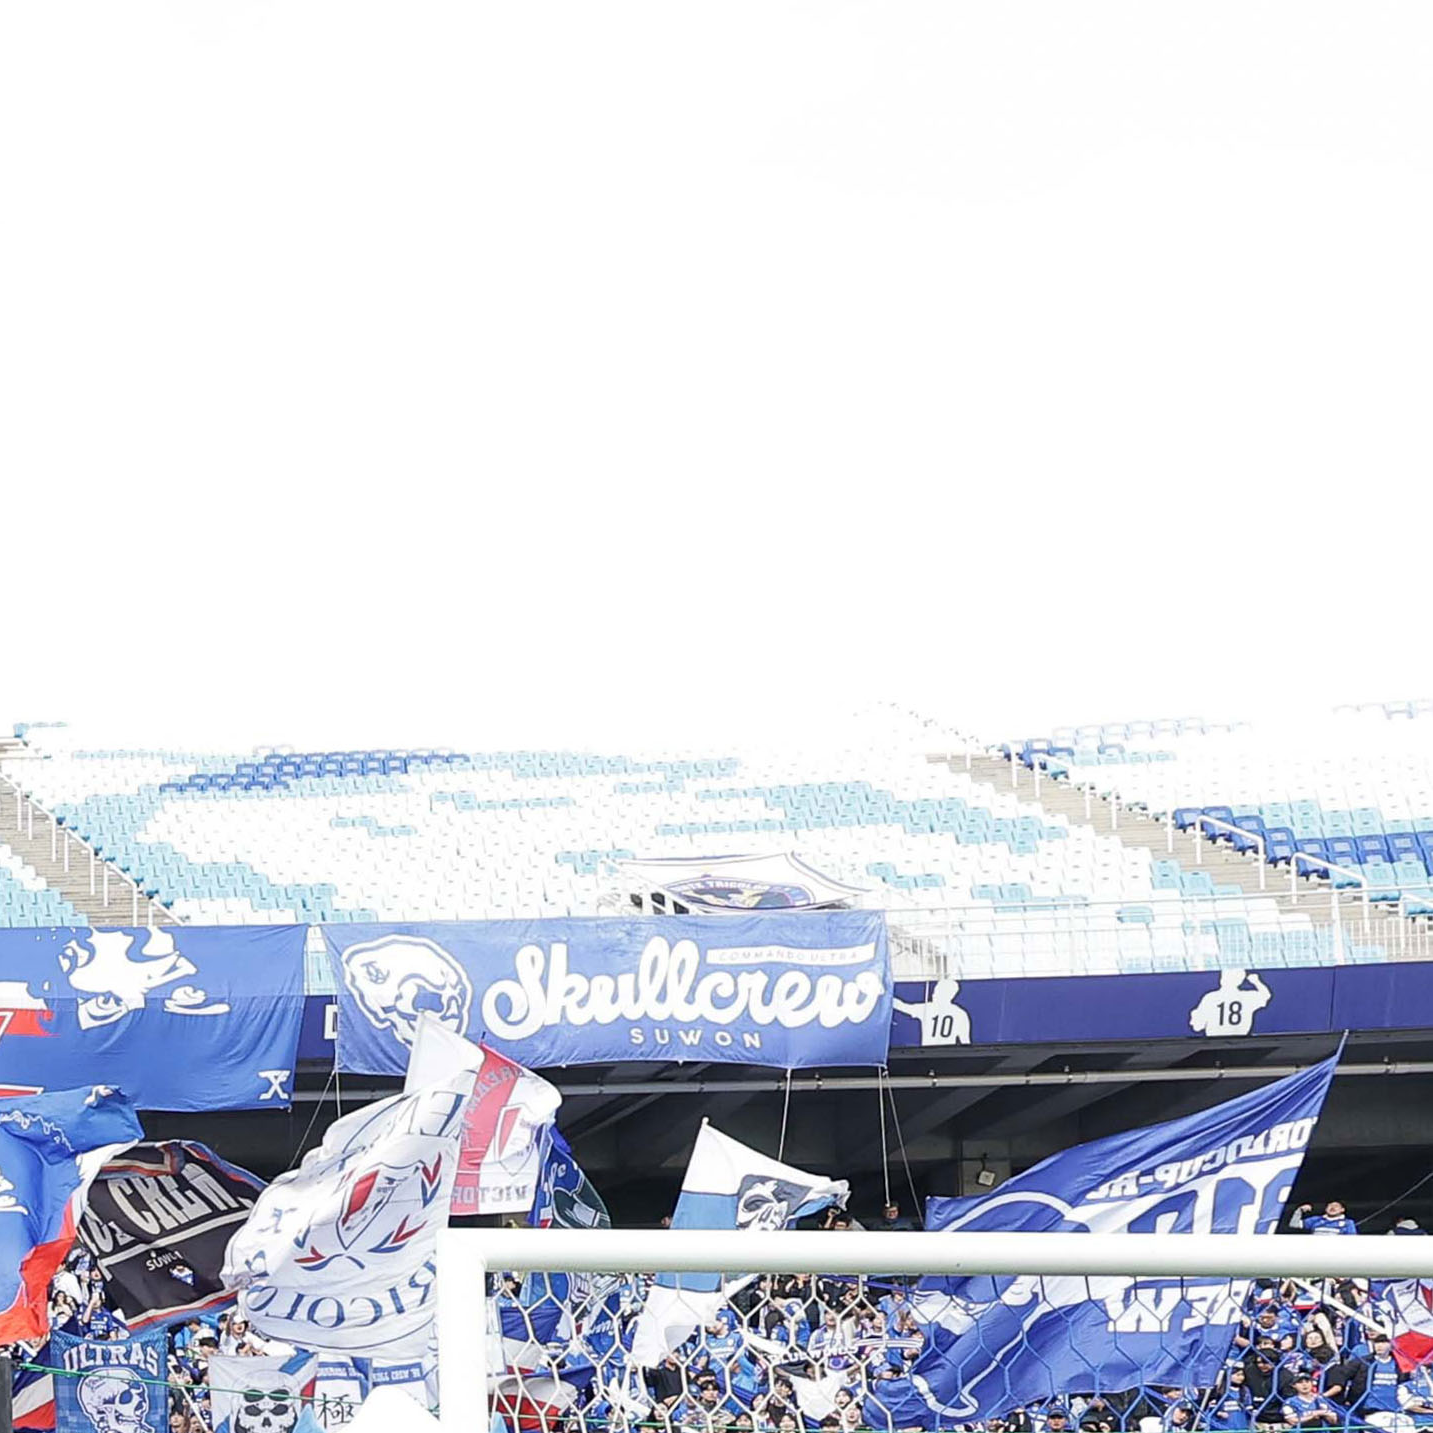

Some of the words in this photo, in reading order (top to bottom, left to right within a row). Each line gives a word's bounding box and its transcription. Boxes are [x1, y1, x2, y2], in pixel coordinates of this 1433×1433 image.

[482, 935, 885, 1041] Skullcrew
[1216, 1001, 1242, 1026] 18
[630, 1027, 762, 1049] SUWON
[931, 1015, 953, 1039] 10
[62, 1342, 160, 1377] ULTRAS
